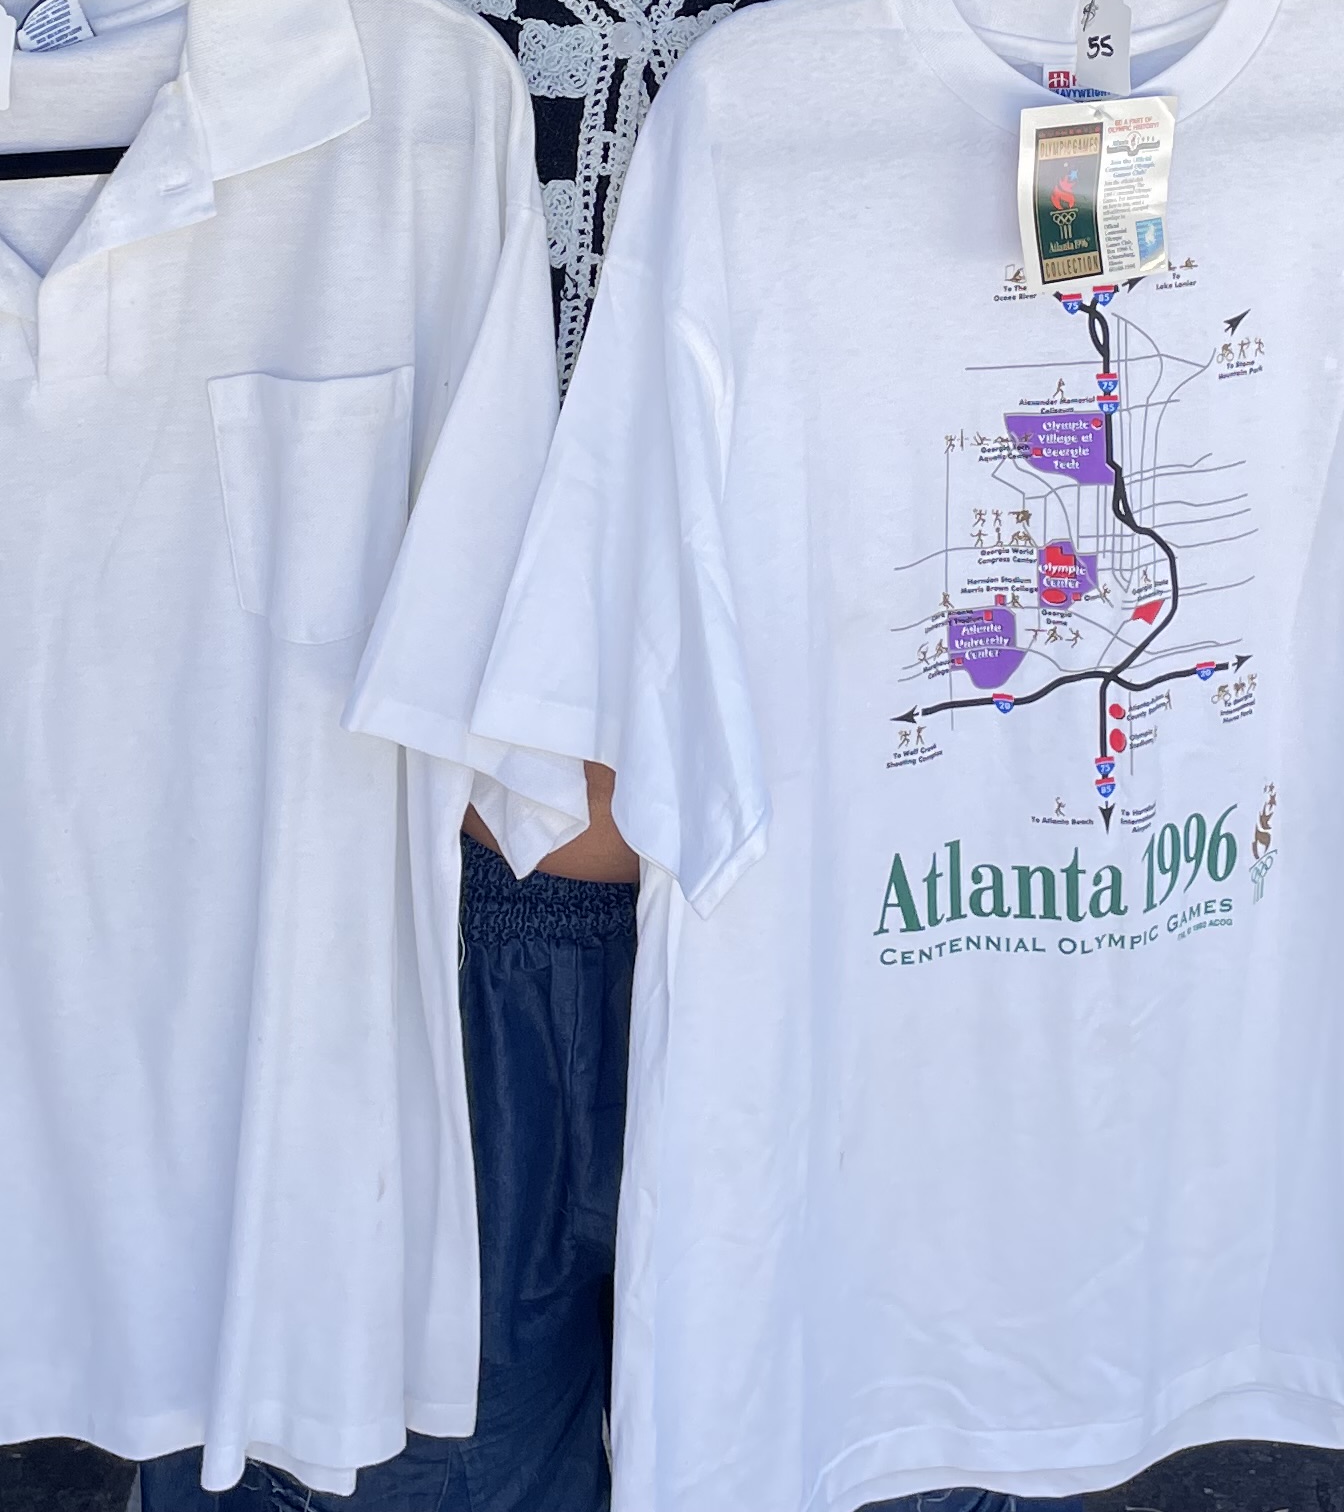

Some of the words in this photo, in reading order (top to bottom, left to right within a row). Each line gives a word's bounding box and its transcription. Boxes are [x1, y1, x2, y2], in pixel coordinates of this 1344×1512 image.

[1086, 34, 1114, 60] 55
[1045, 255, 1099, 279] COLLECTION
[1067, 302, 1079, 310] 75
[1102, 381, 1114, 390] 75
[1102, 403, 1115, 411] 85
[1042, 419, 1089, 432] Olympic
[1038, 434, 1078, 445] Village
[1053, 459, 1080, 470] Tech
[1038, 562, 1087, 576] Olympic
[1042, 576, 1082, 588] Center
[964, 649, 1000, 660] Center
[872, 839, 1129, 936] Atlanta
[1141, 803, 1238, 914] 1996
[879, 936, 1046, 966] CENTENNIAL
[1058, 925, 1159, 955] OLYMPIC
[1166, 898, 1233, 933] GAMES
